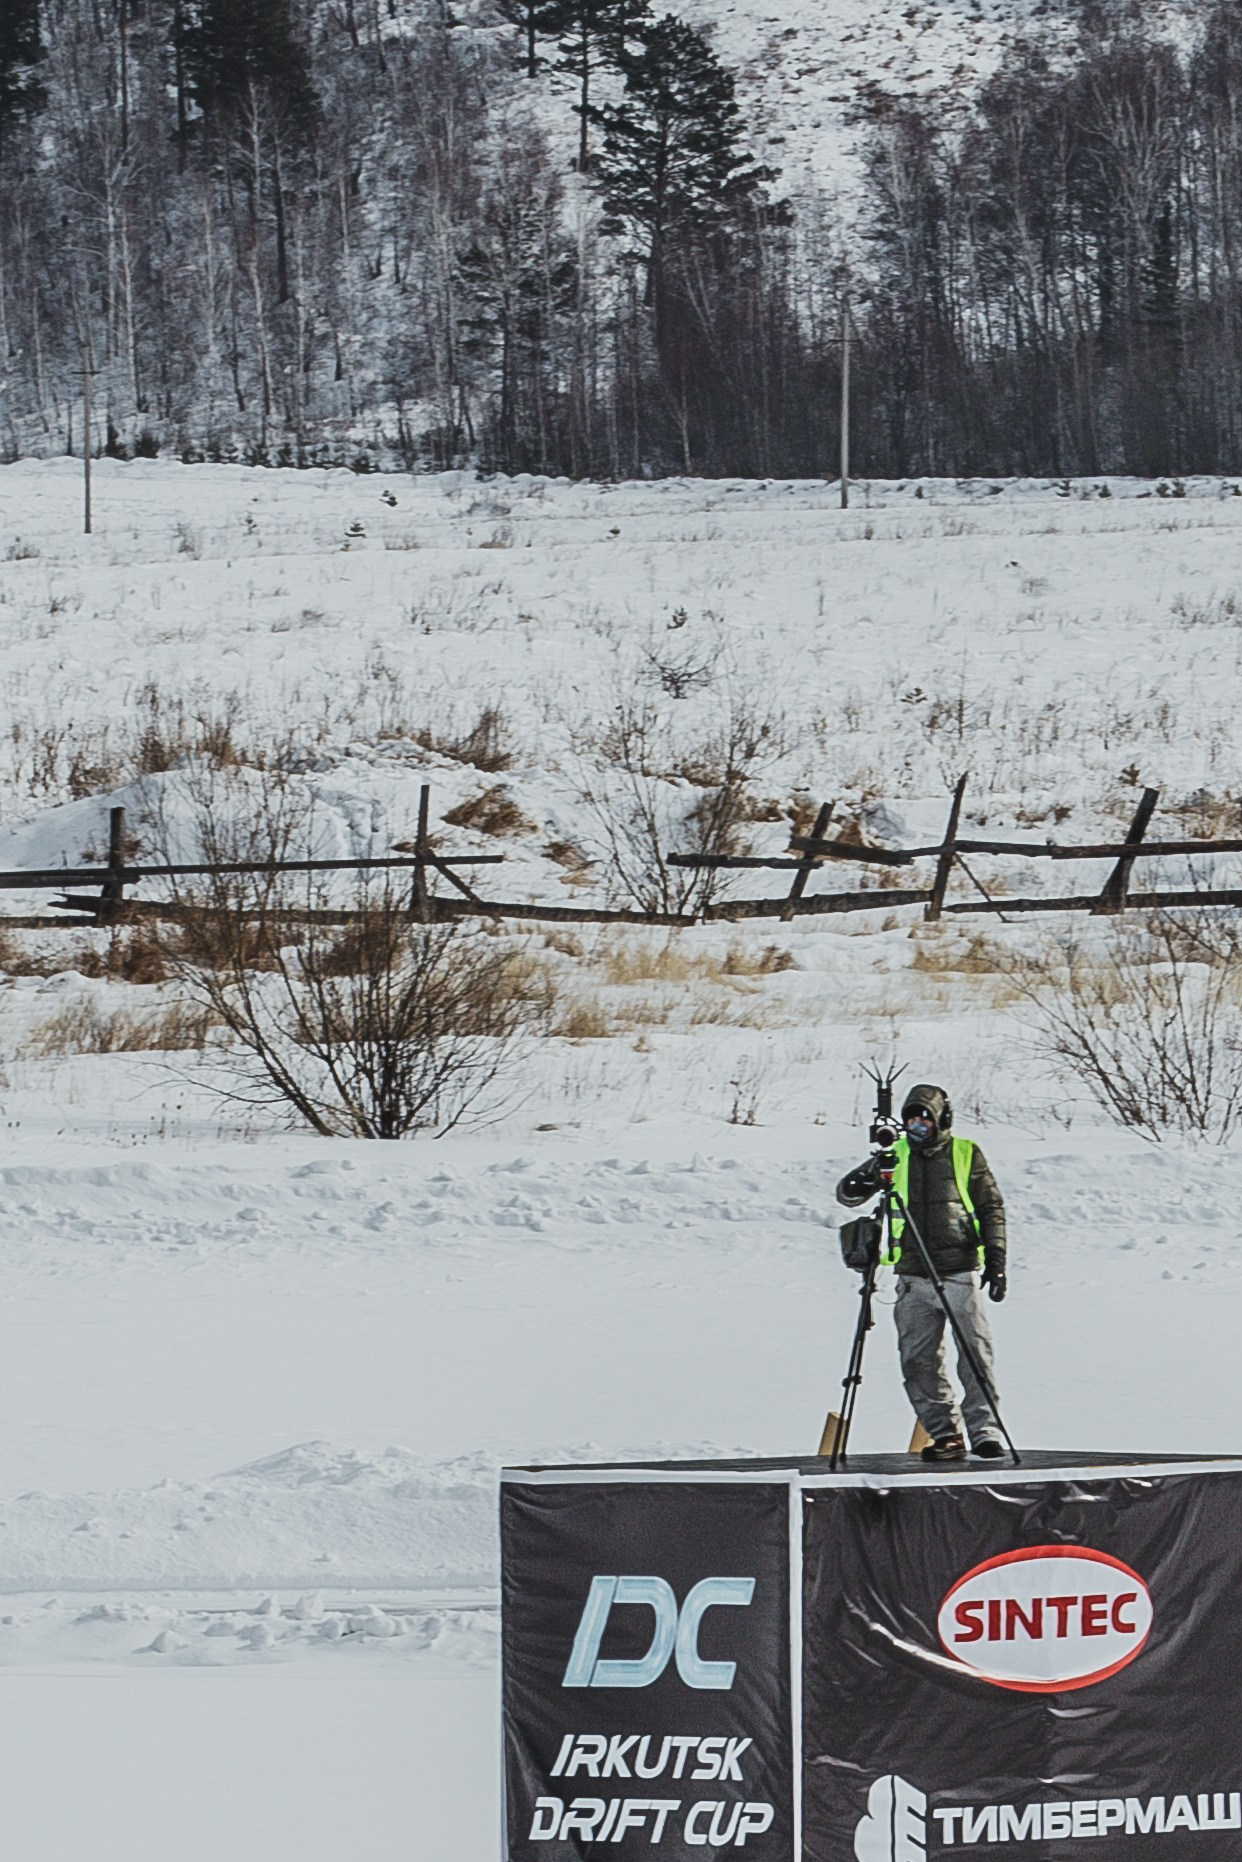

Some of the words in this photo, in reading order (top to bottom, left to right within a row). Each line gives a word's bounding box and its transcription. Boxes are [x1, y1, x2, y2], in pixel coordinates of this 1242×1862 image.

[953, 1592, 1138, 1643] SINTEC
[550, 1734, 753, 1781] IRKUTSK
[528, 1796, 682, 1844] DRIFT
[684, 1800, 774, 1847] CUP
[932, 1792, 1242, 1845] ТИМБЕРМАШ
